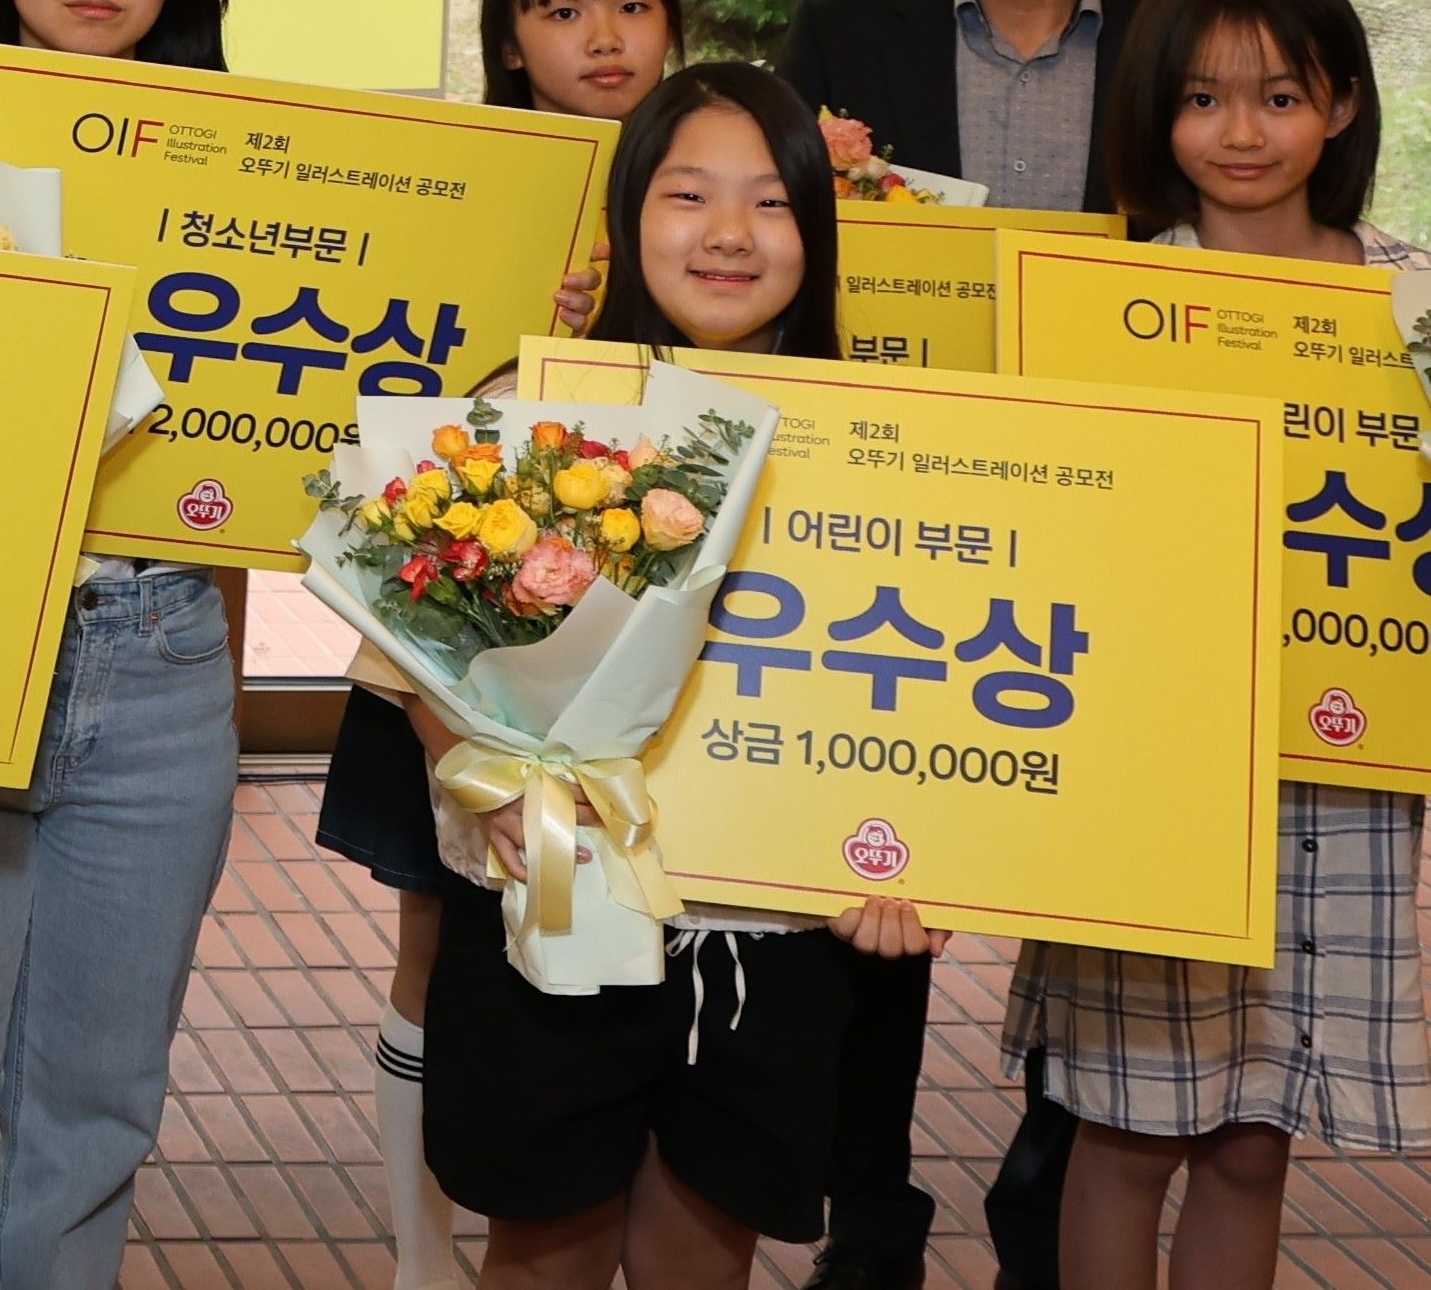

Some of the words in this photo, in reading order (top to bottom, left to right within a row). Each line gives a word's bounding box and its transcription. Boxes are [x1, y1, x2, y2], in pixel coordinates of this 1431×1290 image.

[72, 113, 164, 157] OIF
[169, 124, 217, 139] OTTOGI
[245, 132, 290, 154] 제2회
[164, 151, 208, 165] Festival
[167, 138, 227, 154] Illustration
[238, 157, 290, 179] 오뚜기
[296, 163, 412, 193] 일러스트레이션
[416, 178, 466, 200] 공모전
[181, 211, 347, 263] 청소년부문
[846, 276, 951, 297] 일러스트레이션
[1123, 299, 1211, 343] OIF
[1217, 309, 1264, 323] OTTOGI
[1293, 316, 1337, 337] 제2회
[133, 271, 467, 398] 우수상
[1217, 323, 1278, 338] Illustration
[850, 334, 910, 366] 부문
[1217, 336, 1262, 351] Festival
[1293, 341, 1343, 363] 오뚜기
[1349, 346, 1416, 370] 일러스트
[780, 417, 816, 430] TOGI
[849, 421, 899, 443] 제2회
[1284, 402, 1344, 443] 린이
[1355, 409, 1420, 452] 부문
[773, 432, 830, 446] ustration
[769, 447, 811, 459] estival
[847, 448, 904, 471] 오뚜기
[912, 453, 1048, 484] 일러스트레이션
[1055, 466, 1113, 490] 공모전
[788, 510, 901, 557] 어린이
[915, 521, 993, 565] 부문
[1283, 608, 1429, 657] ,000,00
[698, 569, 1090, 731] 우수상
[701, 718, 784, 765] 상금
[797, 730, 1058, 795] 1,000,000원
[853, 846, 900, 870] 오뚜기
